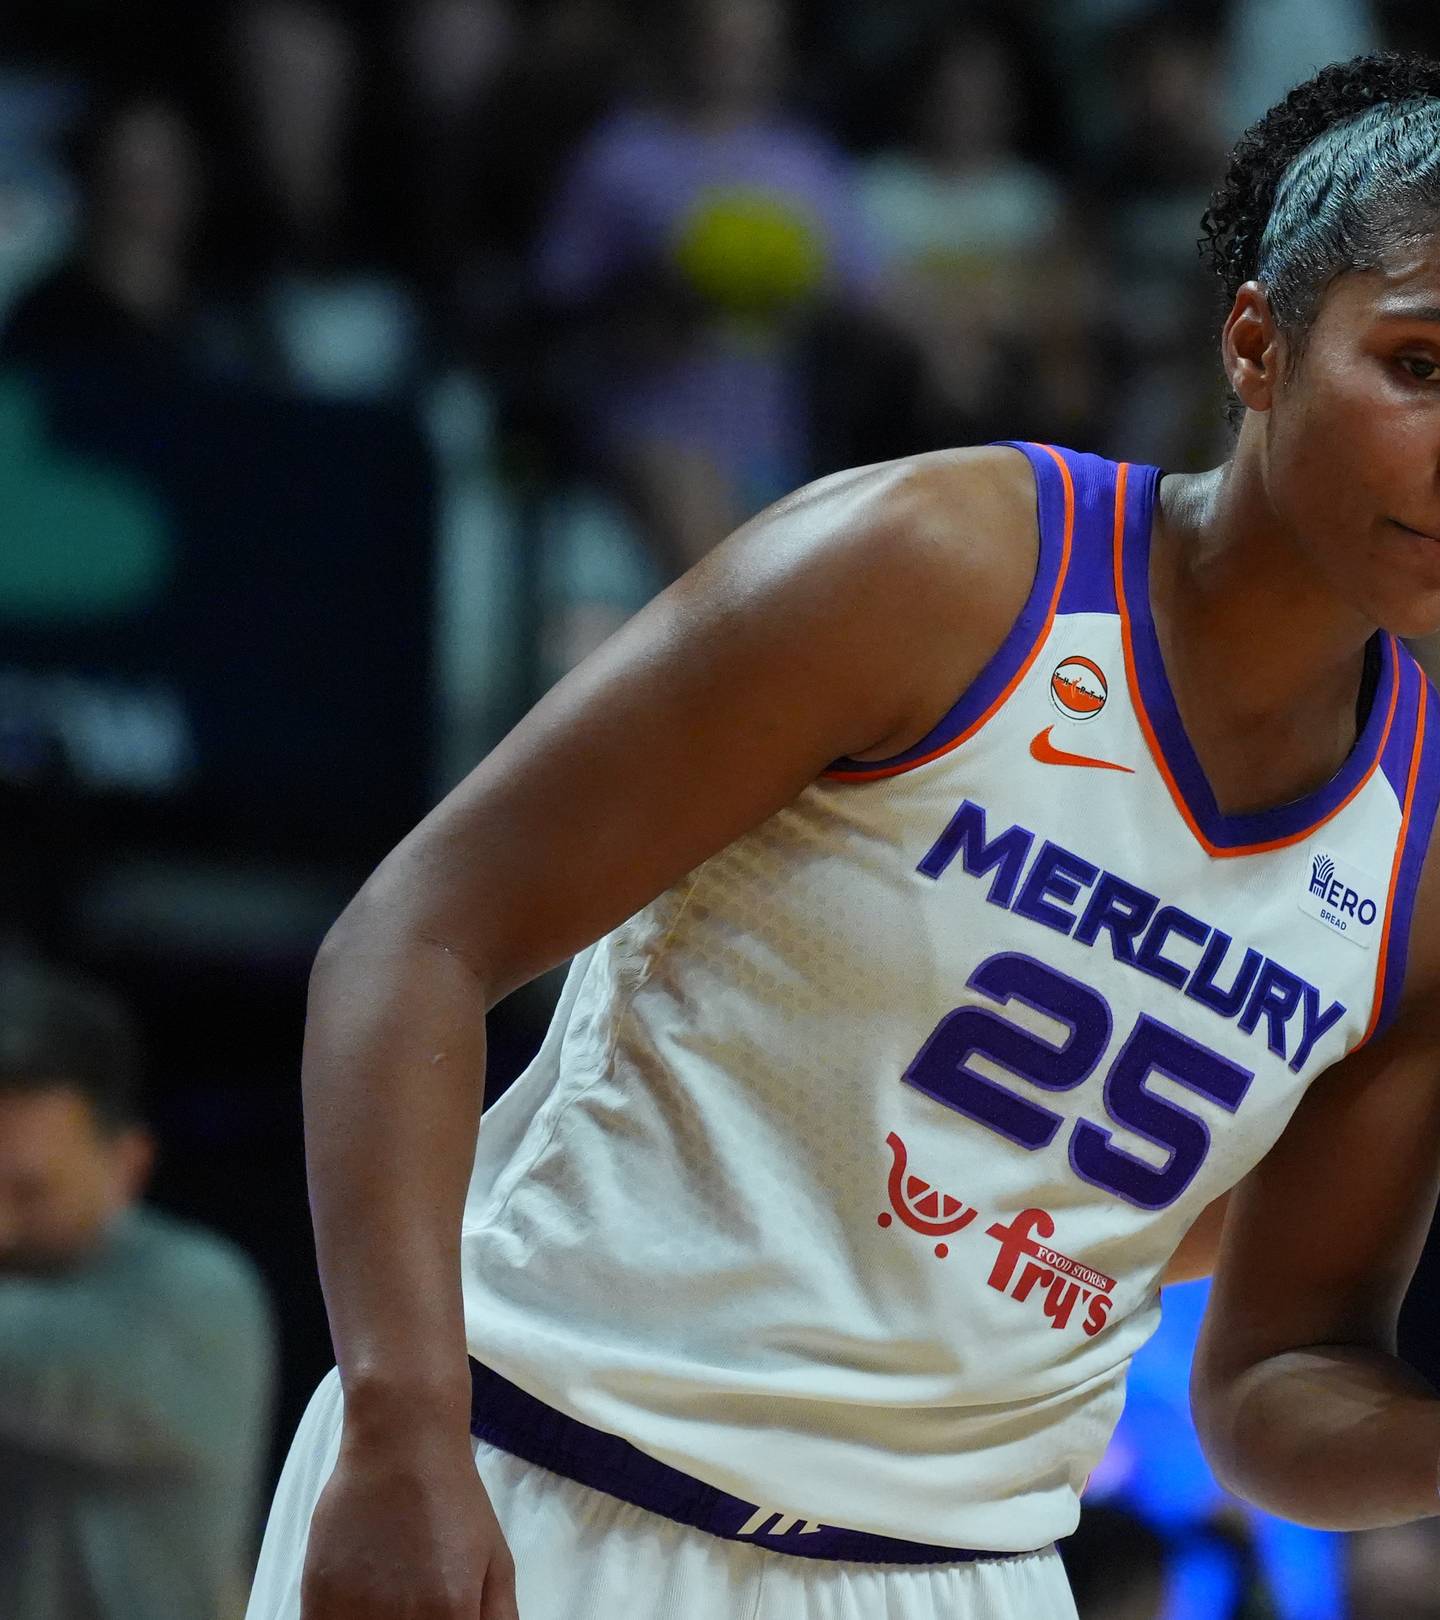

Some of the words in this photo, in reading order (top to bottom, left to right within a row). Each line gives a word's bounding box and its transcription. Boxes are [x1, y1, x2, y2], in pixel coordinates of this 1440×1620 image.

[917, 799, 1347, 1073] MERCURY
[1309, 854, 1377, 926] HERO
[1320, 909, 1347, 931] BREAD
[901, 951, 1255, 1211] 25
[985, 1208, 1113, 1337] fry's
[1037, 1246, 1072, 1272] FOOD
[1071, 1265, 1108, 1290] STORES
